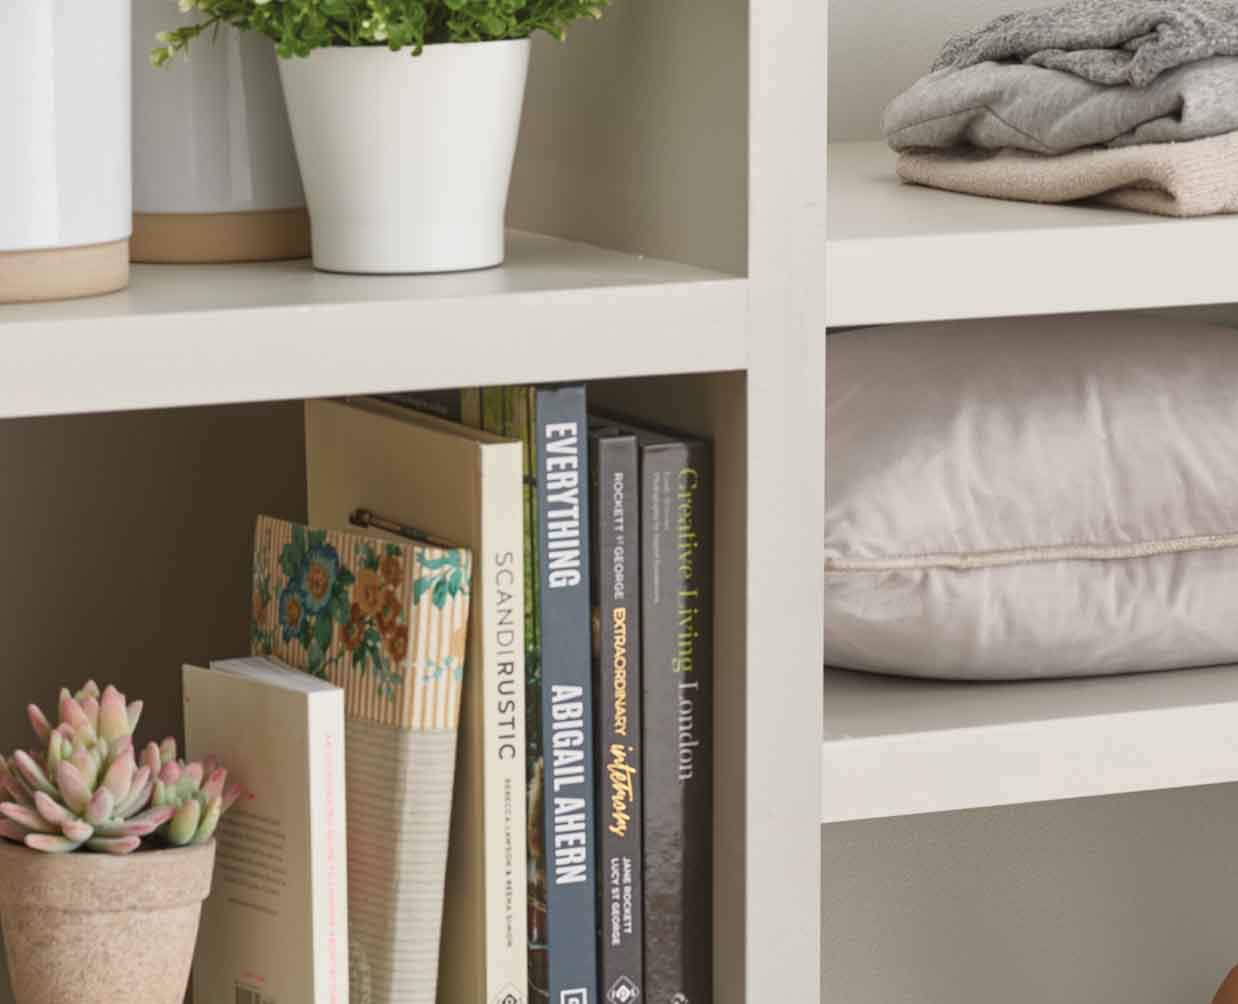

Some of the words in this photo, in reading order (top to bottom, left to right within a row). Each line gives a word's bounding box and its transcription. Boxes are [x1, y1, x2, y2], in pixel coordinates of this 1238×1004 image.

[545, 422, 581, 588] EVERYTHING
[613, 472, 625, 532] ROCKETT
[677, 467, 699, 580] Creative
[613, 546, 625, 601] GEORGE
[612, 607, 627, 737] EXTRAORDINARY
[671, 590, 699, 673] Living
[551, 685, 585, 792] ABIGAIL
[678, 682, 700, 781] London
[553, 797, 587, 885] AHERN
[610, 857, 620, 885] LUCY
[610, 902, 621, 946] GEORGE
[622, 886, 633, 934] ROCKETT
